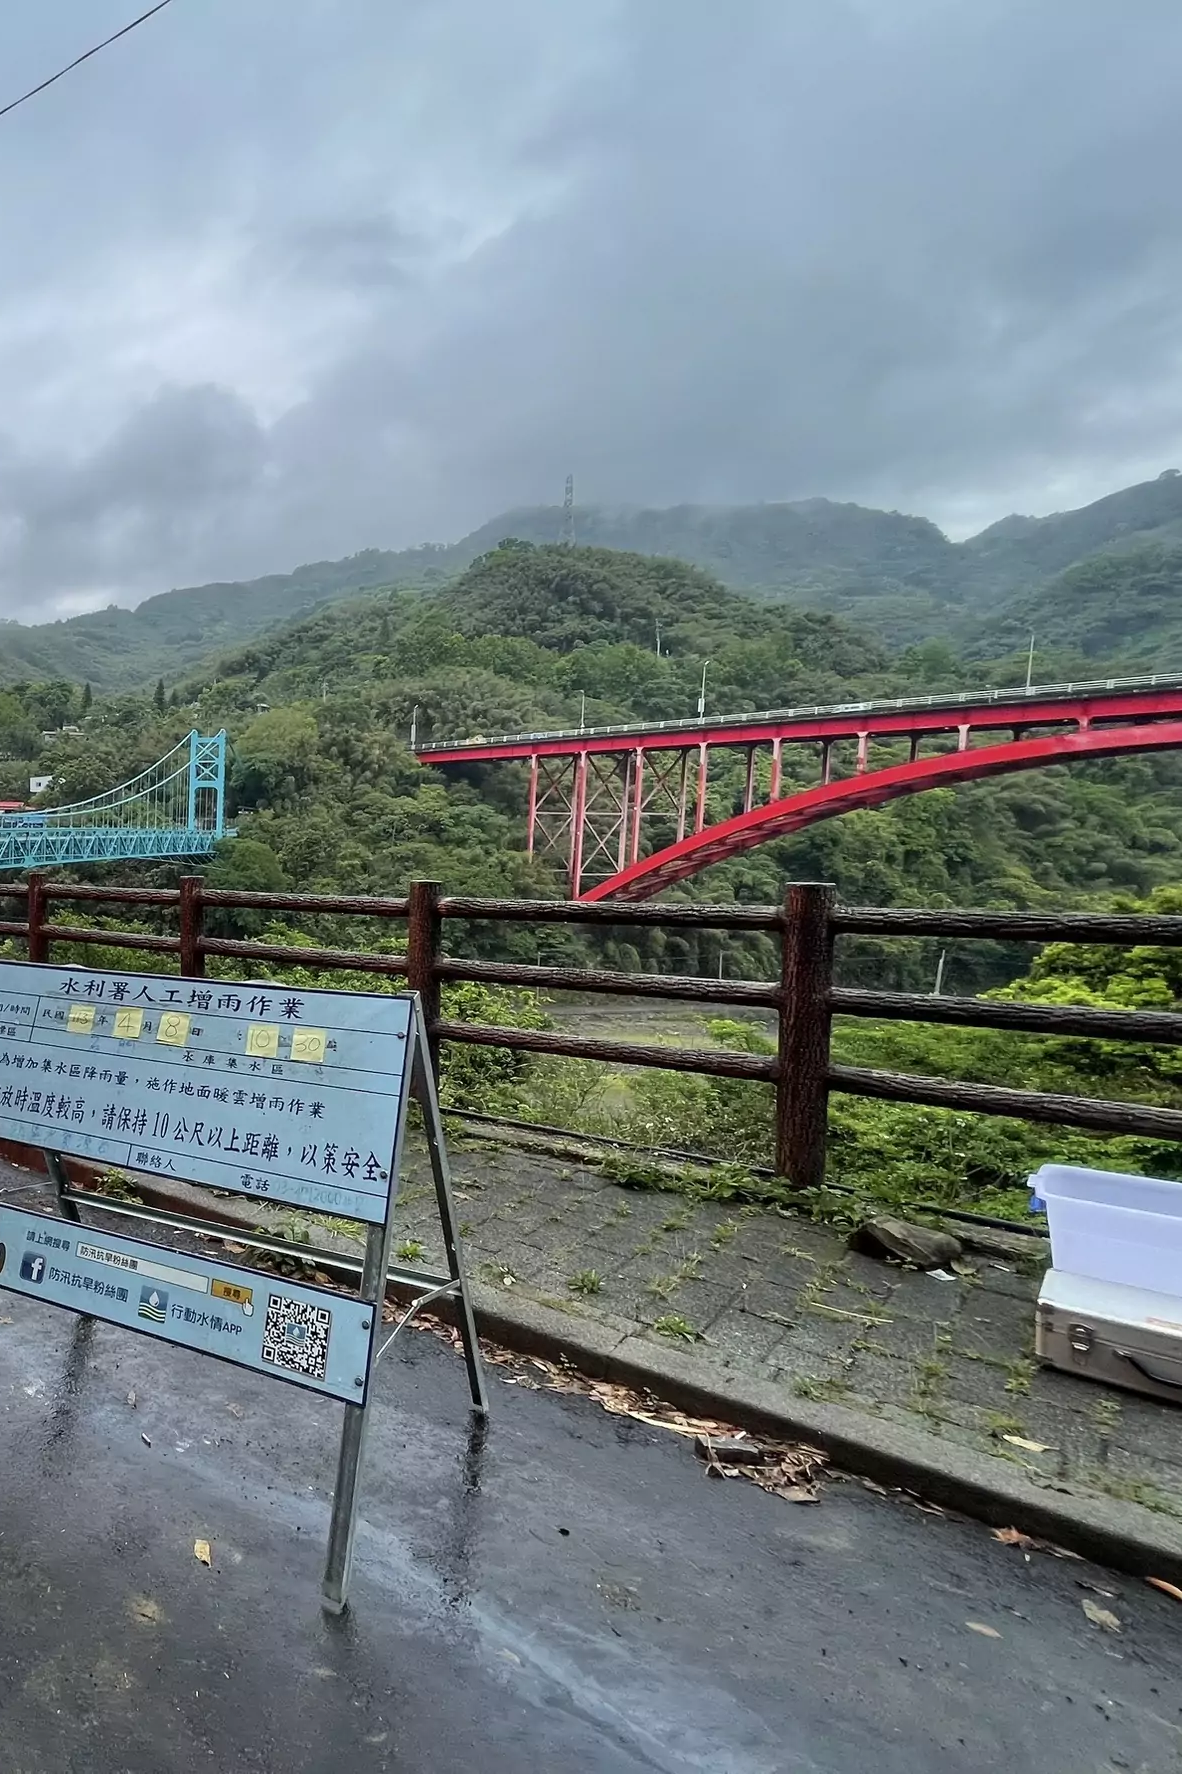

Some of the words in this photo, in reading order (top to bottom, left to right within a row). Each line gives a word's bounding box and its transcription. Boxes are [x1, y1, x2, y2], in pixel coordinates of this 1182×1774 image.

[60, 977, 305, 1019] 水利署人工增雨作業
[42, 1008, 65, 1021] 民國
[97, 1015, 109, 1026] 年
[117, 1013, 134, 1033] 4
[143, 1021, 152, 1032] 月
[165, 1015, 181, 1037] 8
[191, 1027, 203, 1037] 日
[250, 1029, 270, 1052] 10
[295, 1033, 321, 1053] 30
[181, 1050, 284, 1076] 水庫集水區
[135, 1152, 177, 1173] 聯絡人
[240, 1174, 270, 1192] 電話
[26, 1230, 71, 1252] 請上網搜尋
[80, 1245, 139, 1271] 防汛抗旱粉絲團
[48, 1266, 129, 1302] 防汛抗旱粉絲團
[223, 1286, 242, 1300] 搜尋
[170, 1303, 243, 1336] 行動水情APP
